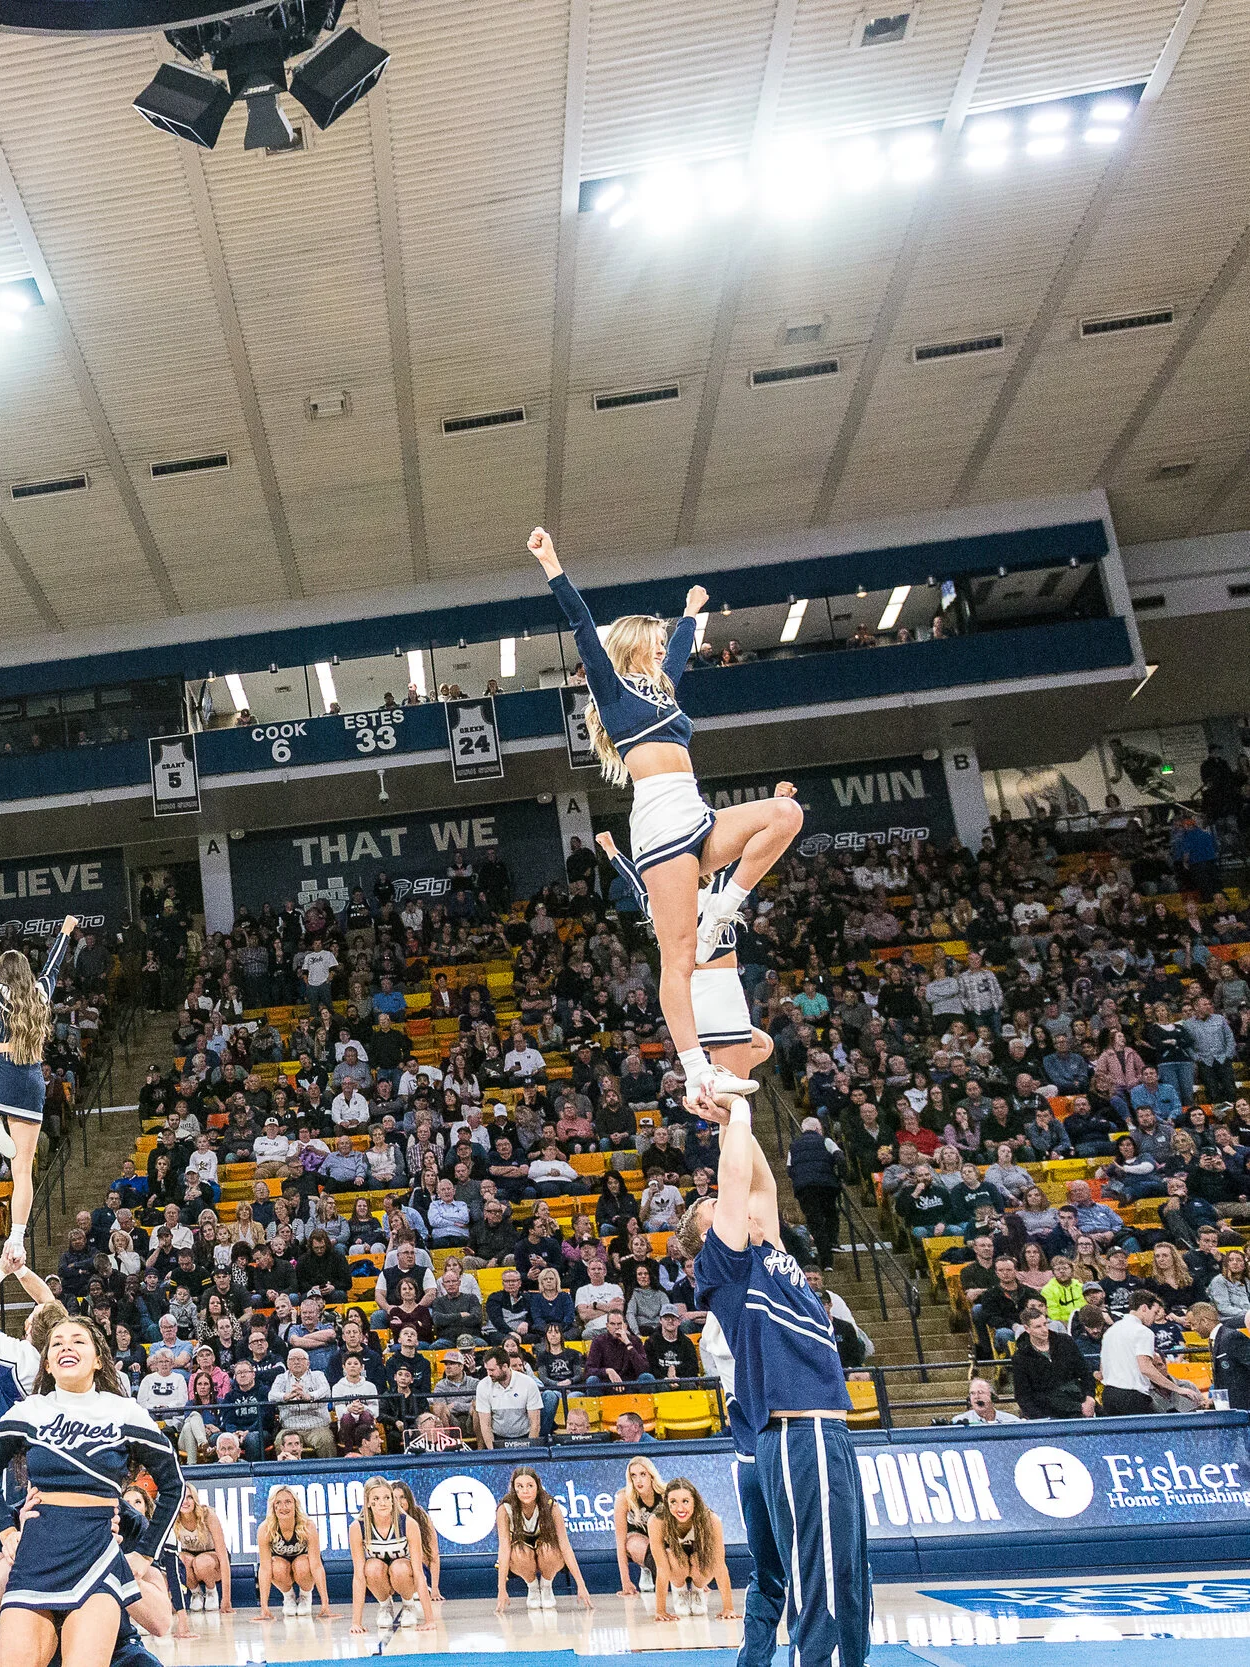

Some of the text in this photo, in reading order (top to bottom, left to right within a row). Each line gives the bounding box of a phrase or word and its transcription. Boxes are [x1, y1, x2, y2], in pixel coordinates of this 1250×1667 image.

[344, 709, 406, 730] ESTES
[251, 722, 308, 742] COOK
[355, 728, 398, 753] 33
[271, 739, 292, 763] 6
[458, 735, 491, 755] 24
[953, 754, 970, 770] B
[168, 772, 182, 789] 5
[831, 769, 927, 808] WIN
[566, 799, 582, 815] A
[206, 839, 221, 855] A
[292, 816, 499, 867] THAT WE
[412, 877, 452, 897] Sig
[763, 1249, 808, 1288] Agg
[38, 1413, 119, 1446] Aggies
[1037, 1463, 1067, 1500] F
[1102, 1449, 1242, 1493] Fisher
[855, 1450, 1002, 1526] PONSOR
[451, 1491, 474, 1527] F
[1106, 1492, 1161, 1509] Home
